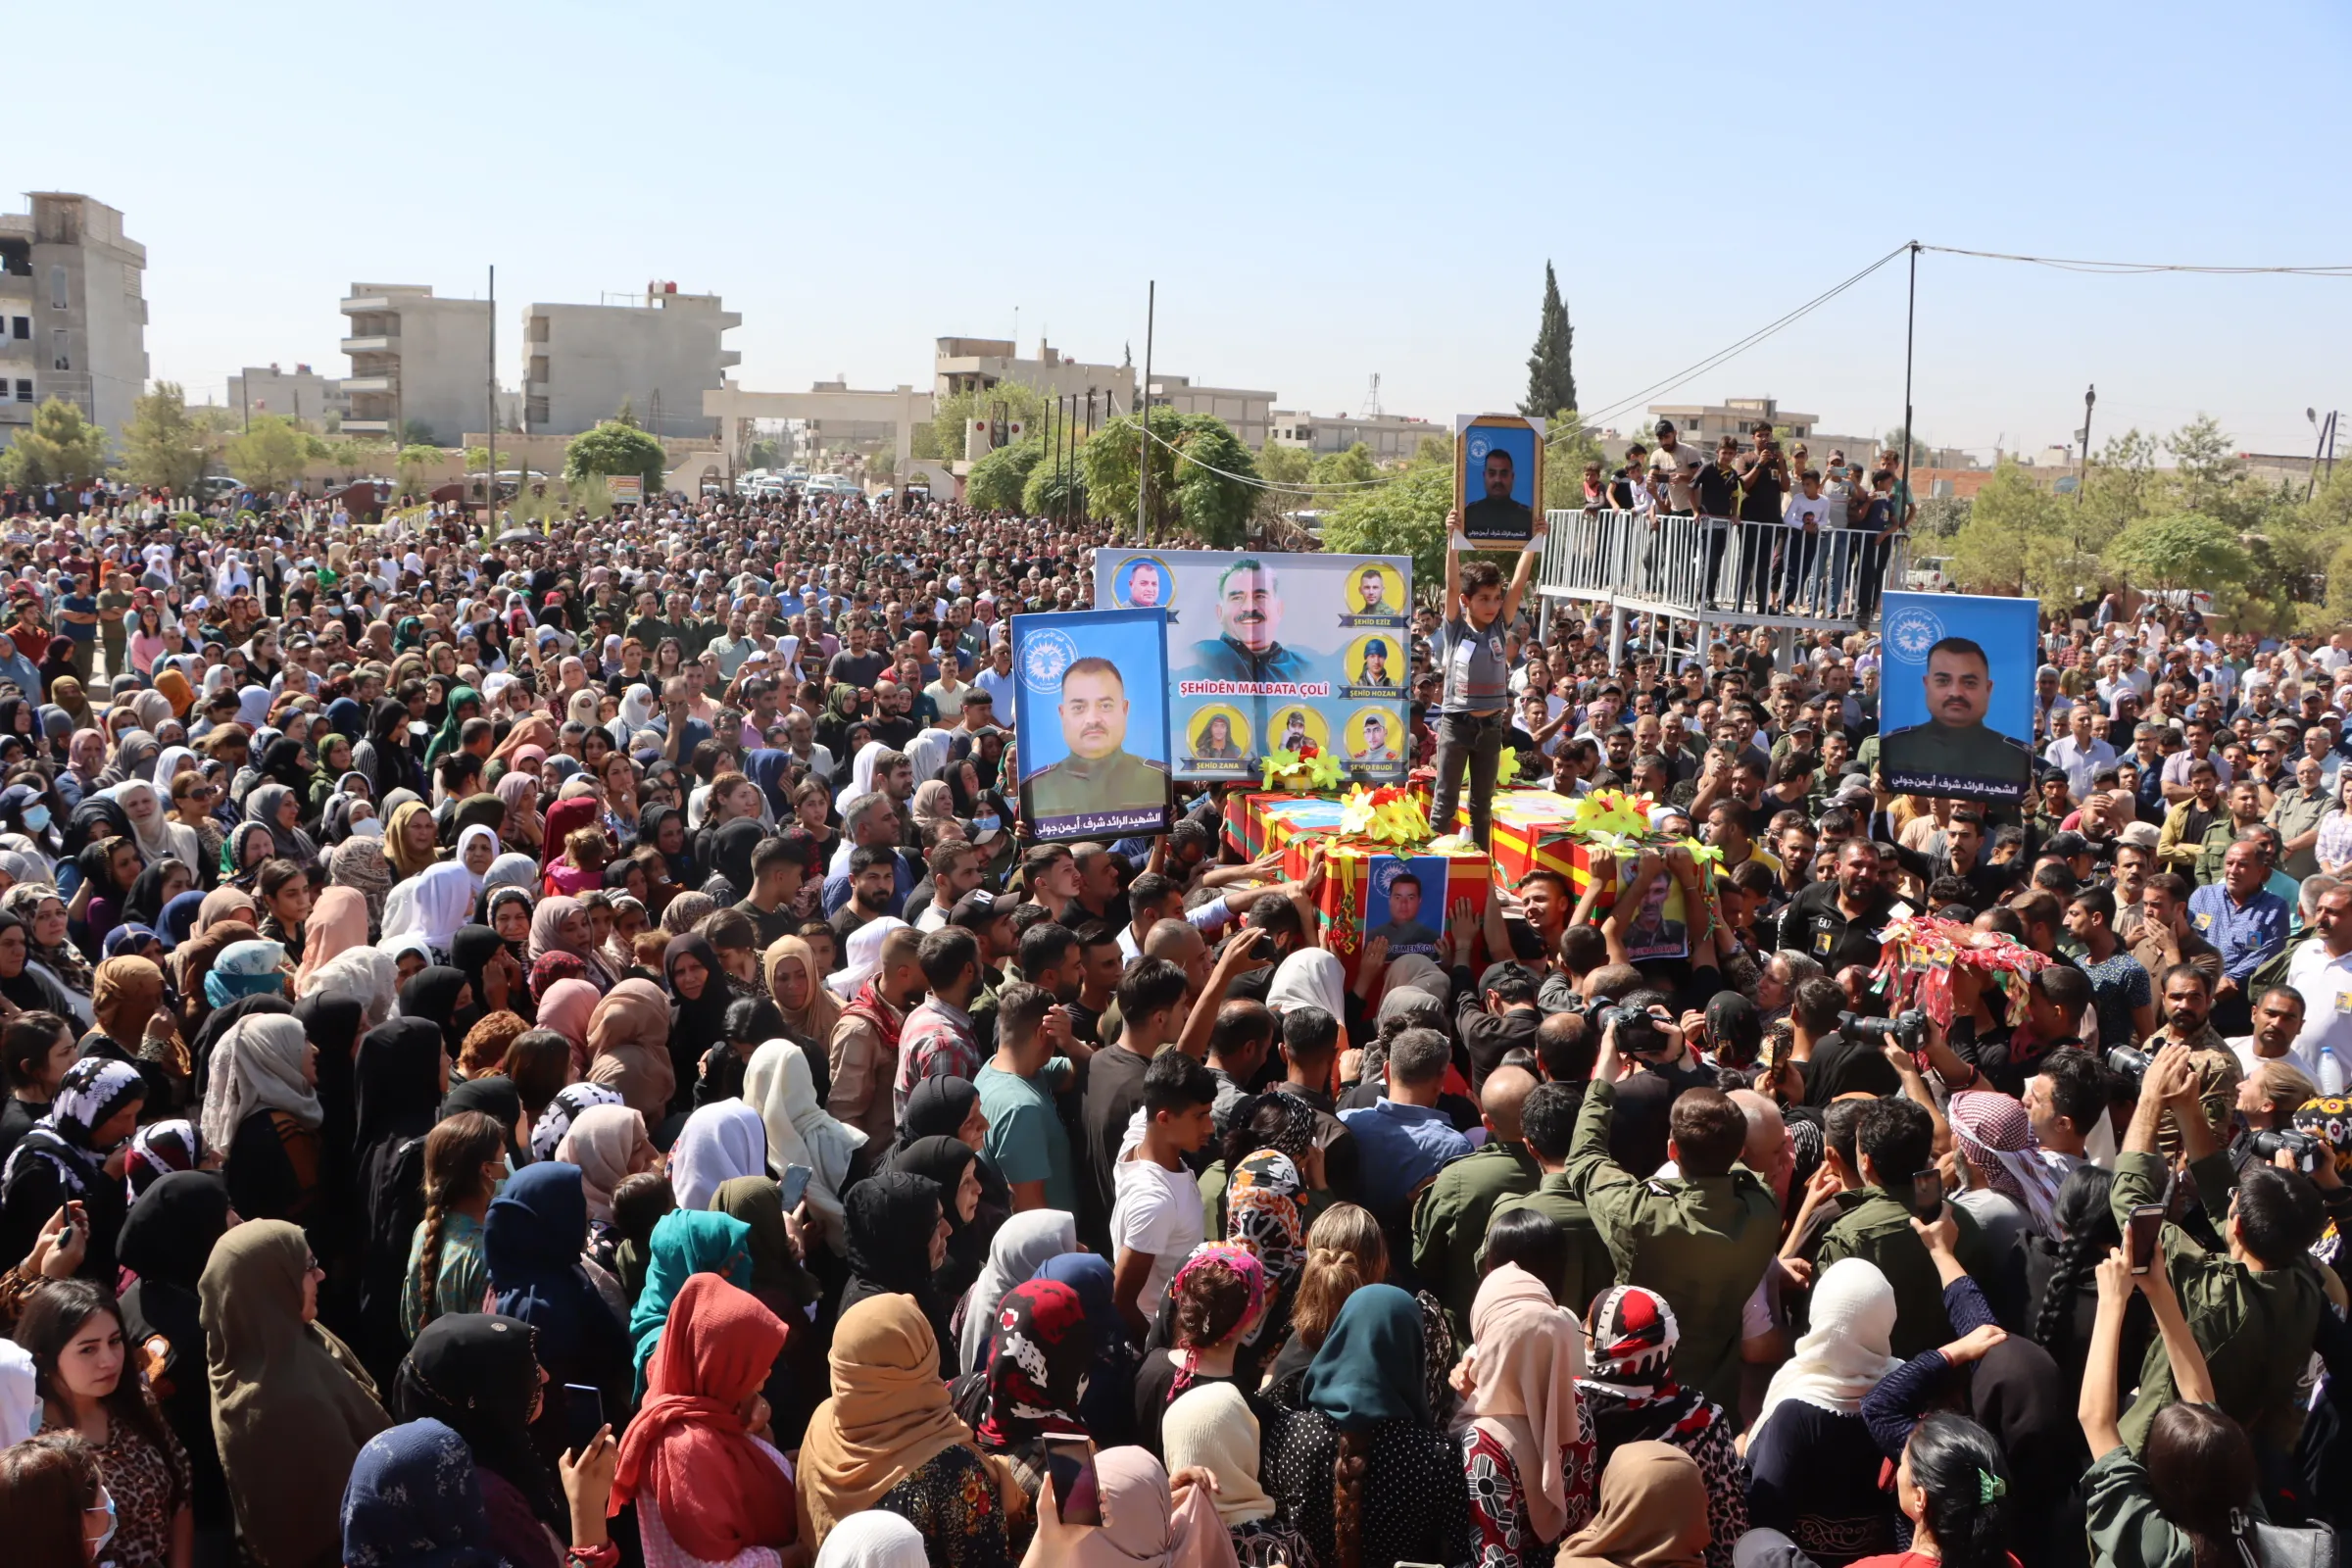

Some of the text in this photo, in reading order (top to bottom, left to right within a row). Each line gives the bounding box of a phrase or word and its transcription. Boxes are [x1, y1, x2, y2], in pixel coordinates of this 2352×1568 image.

[1180, 679, 1329, 697] ŞEHÎDÊN MALBATA ÇOLÎ
[1891, 775, 1915, 787] جولي
[1914, 774, 1936, 789] أيمن
[1962, 781, 1984, 794] الرائد
[1984, 784, 2018, 795] الشهيد
[1057, 815, 1081, 834] أيمن
[1105, 814, 1129, 829] الرائد
[1129, 811, 1161, 827] الشهيد
[1034, 822, 1058, 839] جولي
[1818, 916, 1833, 929] EA7
